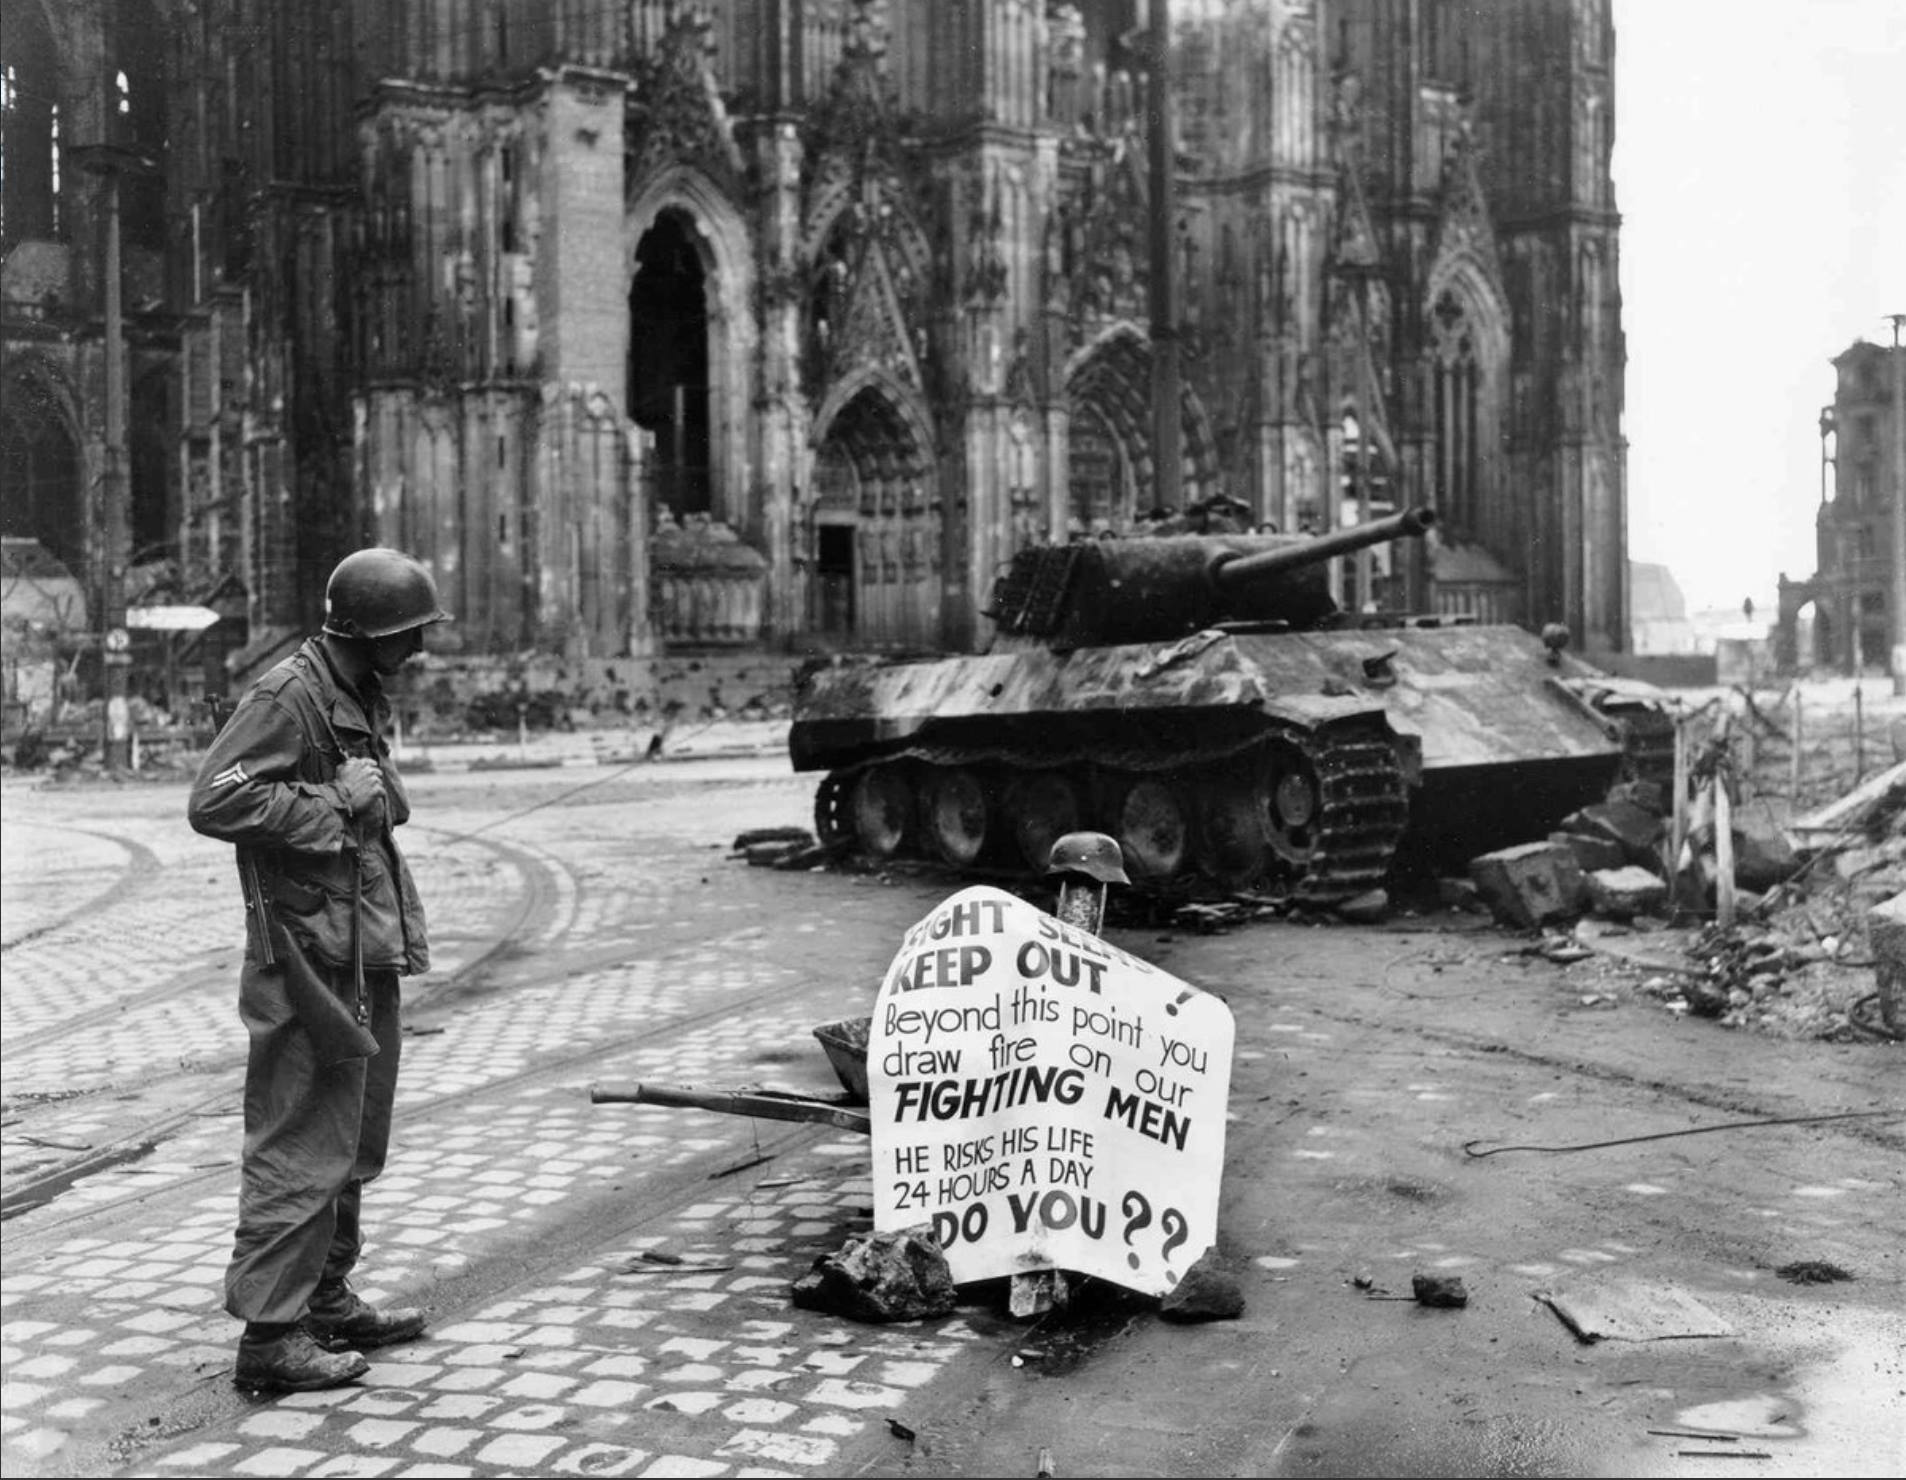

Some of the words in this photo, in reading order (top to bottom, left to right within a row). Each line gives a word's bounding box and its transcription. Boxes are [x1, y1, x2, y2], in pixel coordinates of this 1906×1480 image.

[889, 945, 993, 996] KEEP
[1016, 940, 1108, 995] OUT
[884, 992, 1001, 1045] Beyond
[1010, 984, 1060, 1025] this
[1072, 1005, 1144, 1049] point
[1159, 1035, 1208, 1075] you
[883, 1040, 962, 1078] draw
[988, 1033, 1038, 1071] fire
[1068, 1043, 1112, 1078] on
[1135, 1068, 1194, 1108] our
[893, 1065, 1085, 1123] FIGHTING
[1103, 1085, 1192, 1152] MEN
[895, 1145, 930, 1175] HE
[943, 1135, 995, 1173] RISKS
[1001, 1126, 1039, 1157] HIS
[1047, 1125, 1094, 1159] LIFE
[893, 1180, 931, 1210] 24
[938, 1161, 1011, 1206] HOURS
[1019, 1158, 1037, 1186] A
[1049, 1157, 1094, 1190] DAY
[932, 1201, 989, 1251] DO
